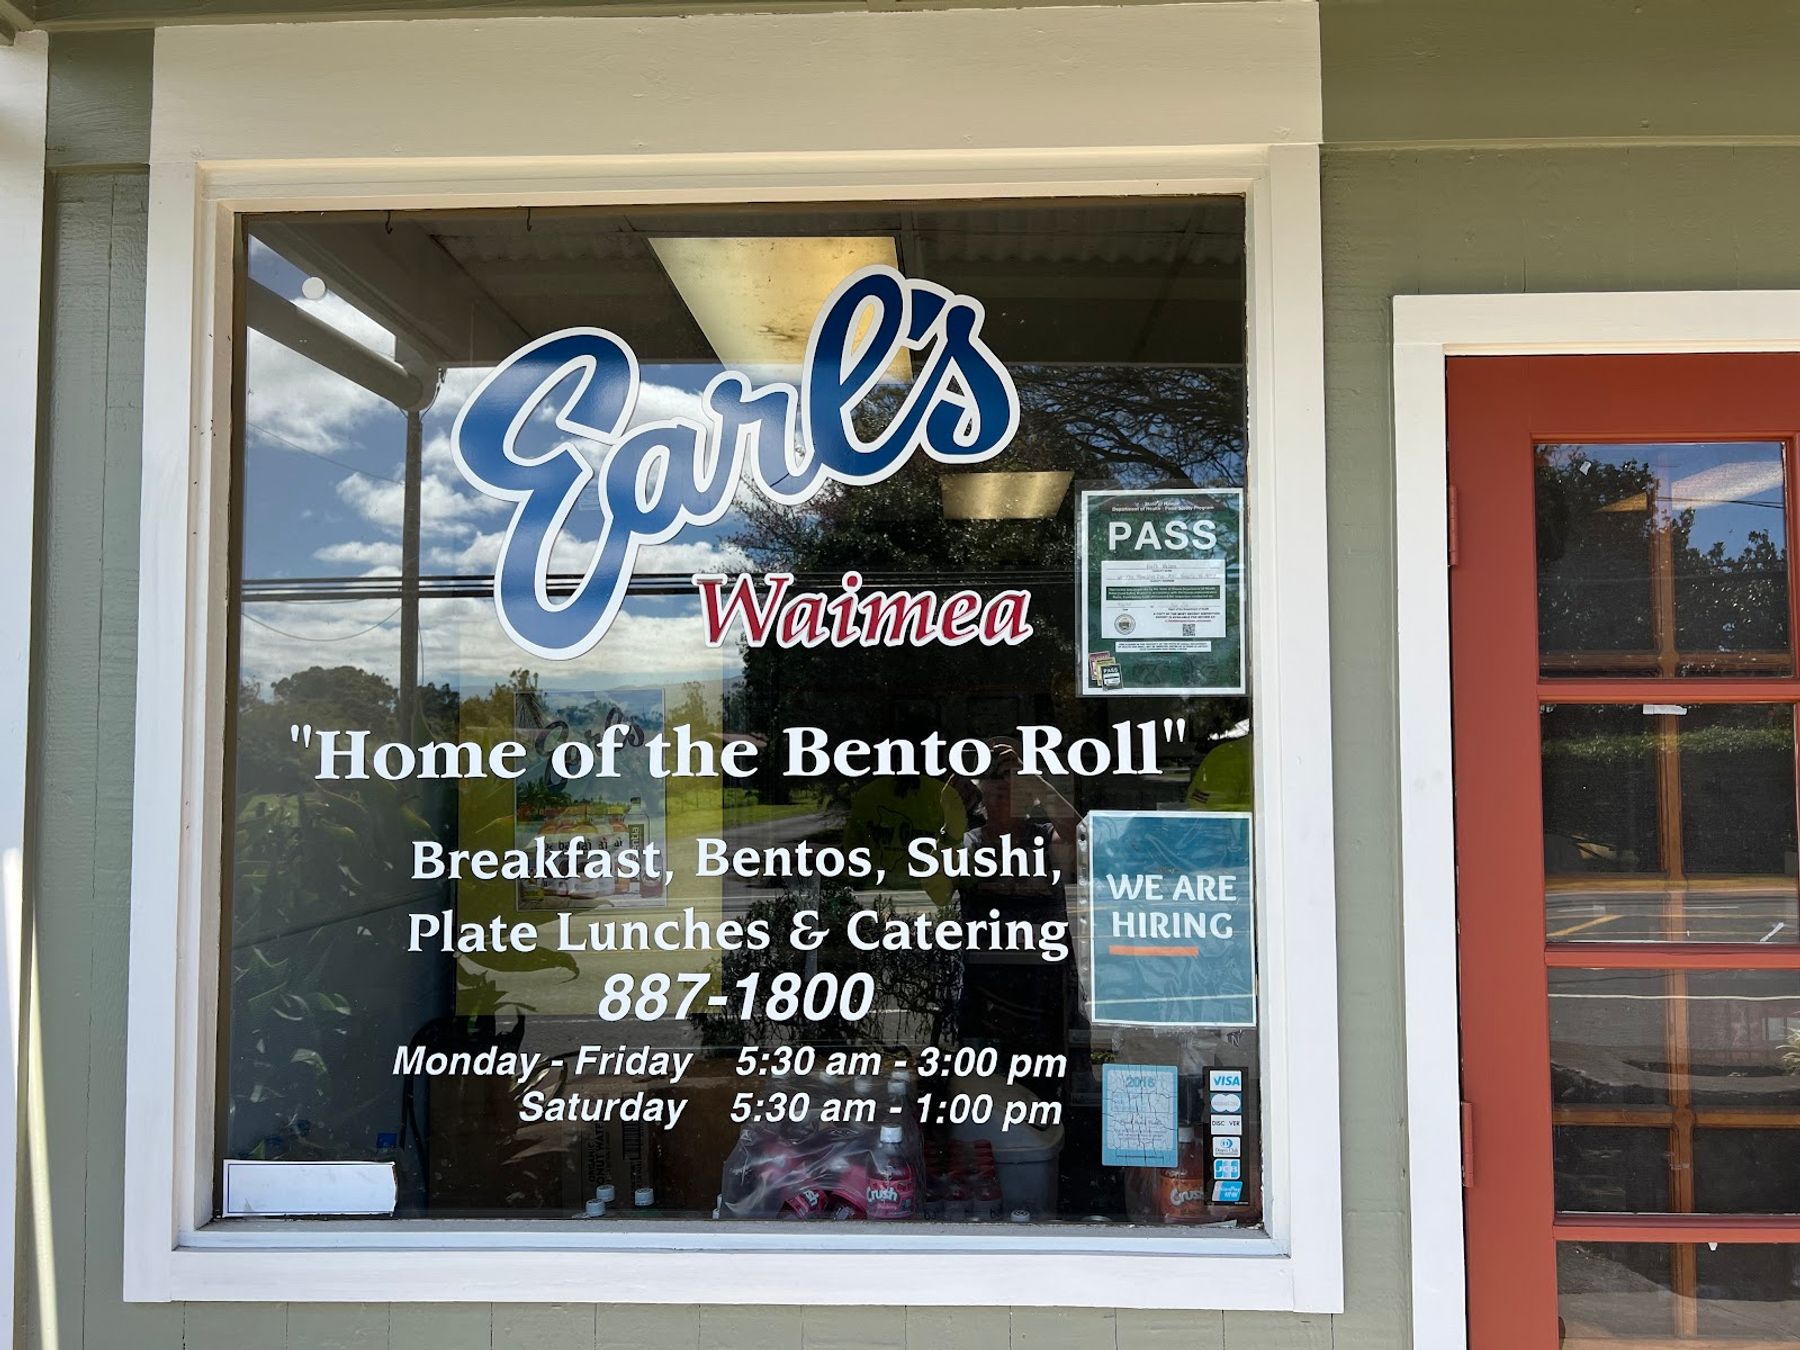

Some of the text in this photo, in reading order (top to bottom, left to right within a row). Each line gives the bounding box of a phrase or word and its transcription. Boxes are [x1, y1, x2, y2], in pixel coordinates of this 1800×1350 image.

[452, 266, 1019, 659] Earl's
[1108, 519, 1217, 551] PASS
[693, 571, 1032, 648] Waimea
[290, 718, 1186, 780] "Home of the Bento Roll"
[411, 836, 674, 886] Breakfast,
[695, 838, 885, 885] Bentos,
[908, 834, 1061, 885] Sushi,
[1106, 873, 1237, 901] WE ARE
[407, 907, 1069, 962] Plate Lunches & Catering
[1112, 911, 1233, 939] HIRING
[598, 972, 875, 1022] 887-1800
[392, 1046, 541, 1084] Monday
[575, 1045, 693, 1084] Friday
[736, 1045, 815, 1076] 5:30
[825, 1052, 881, 1076] am
[918, 1046, 998, 1077] 3:00
[1007, 1054, 1067, 1085] pm
[1214, 1076, 1240, 1086] VISA
[519, 1090, 689, 1130] Saturday
[730, 1092, 810, 1123] 5:30
[820, 1099, 876, 1122] am
[917, 1093, 993, 1124] 1:00
[1001, 1101, 1062, 1132] pm
[1171, 1187, 1203, 1206] Crus
